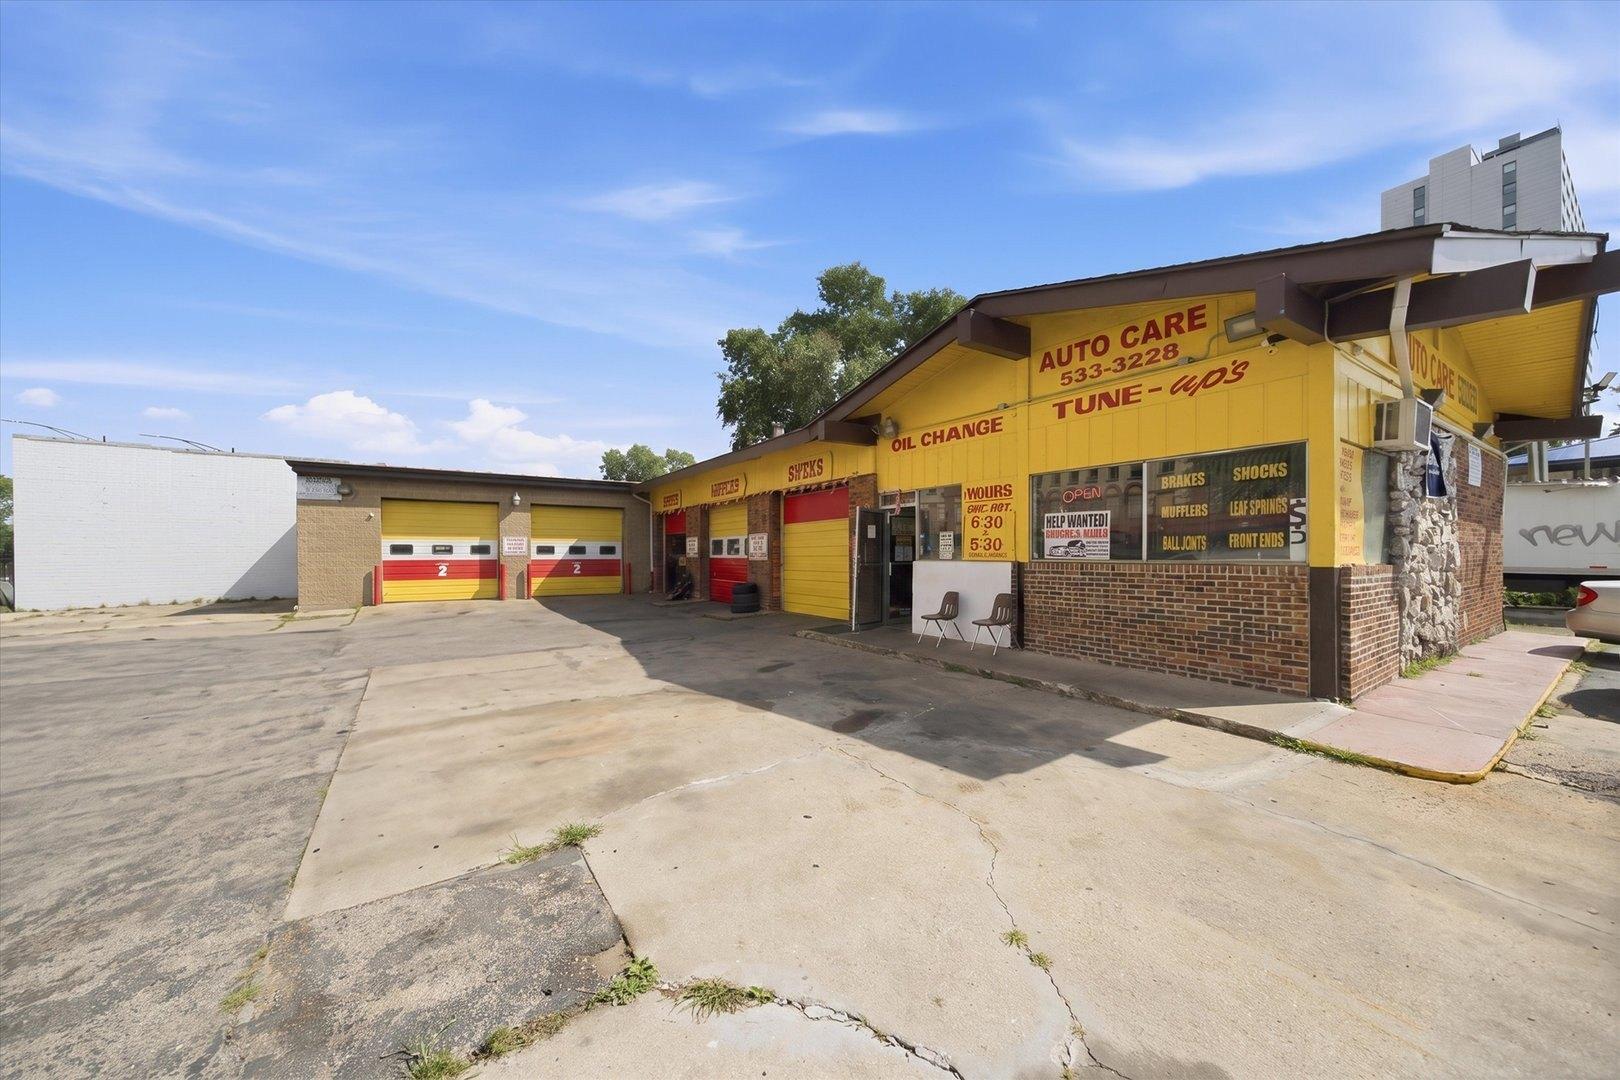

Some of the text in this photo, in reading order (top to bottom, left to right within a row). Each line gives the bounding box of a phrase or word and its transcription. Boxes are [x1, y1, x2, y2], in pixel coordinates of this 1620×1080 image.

[1039, 304, 1207, 373] AUTO CARE
[1060, 343, 1180, 387] 533-3228
[891, 416, 1004, 452] OIL CHANGE
[1233, 462, 1288, 482] SHOCKS
[1161, 471, 1206, 490] BRAKES
[1062, 487, 1101, 503] OPEN
[1161, 503, 1209, 519] MUFFLERS
[1230, 497, 1288, 517] LEAF SPRINGS
[971, 515, 1003, 529] 6:30
[1046, 513, 1109, 529] HELP WANTED!
[970, 537, 1003, 551] 5:30
[1162, 536, 1180, 550] BALL
[1229, 533, 1259, 548] FRONT
[1260, 532, 1284, 548] ENDS
[438, 565, 448, 577] 2
[573, 564, 581, 574] 2
